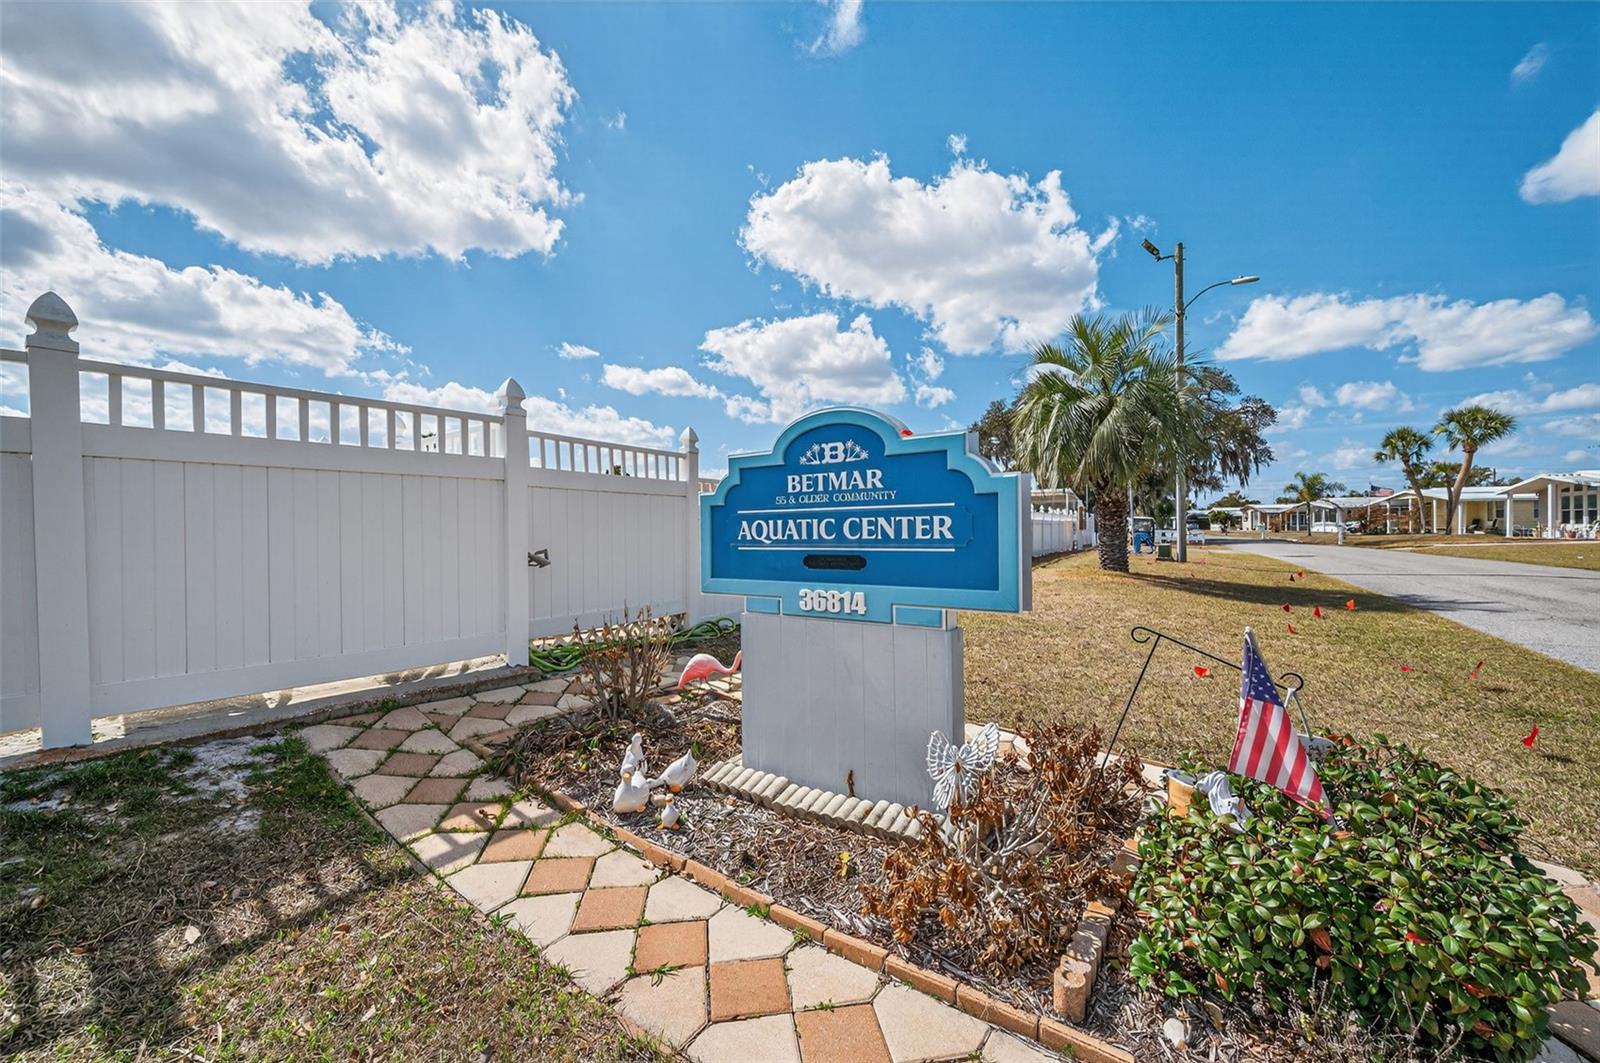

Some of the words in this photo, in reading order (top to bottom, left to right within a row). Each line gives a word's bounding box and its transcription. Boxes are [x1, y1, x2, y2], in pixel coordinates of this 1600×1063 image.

[821, 442, 846, 464] B
[787, 469, 884, 493] BETMAR
[788, 495, 796, 504] &
[799, 494, 830, 504] OLDER
[833, 490, 897, 503] COMMUNITY
[737, 518, 836, 544] AQUATIC
[843, 515, 954, 540] CENTER
[799, 588, 867, 615] 36814
